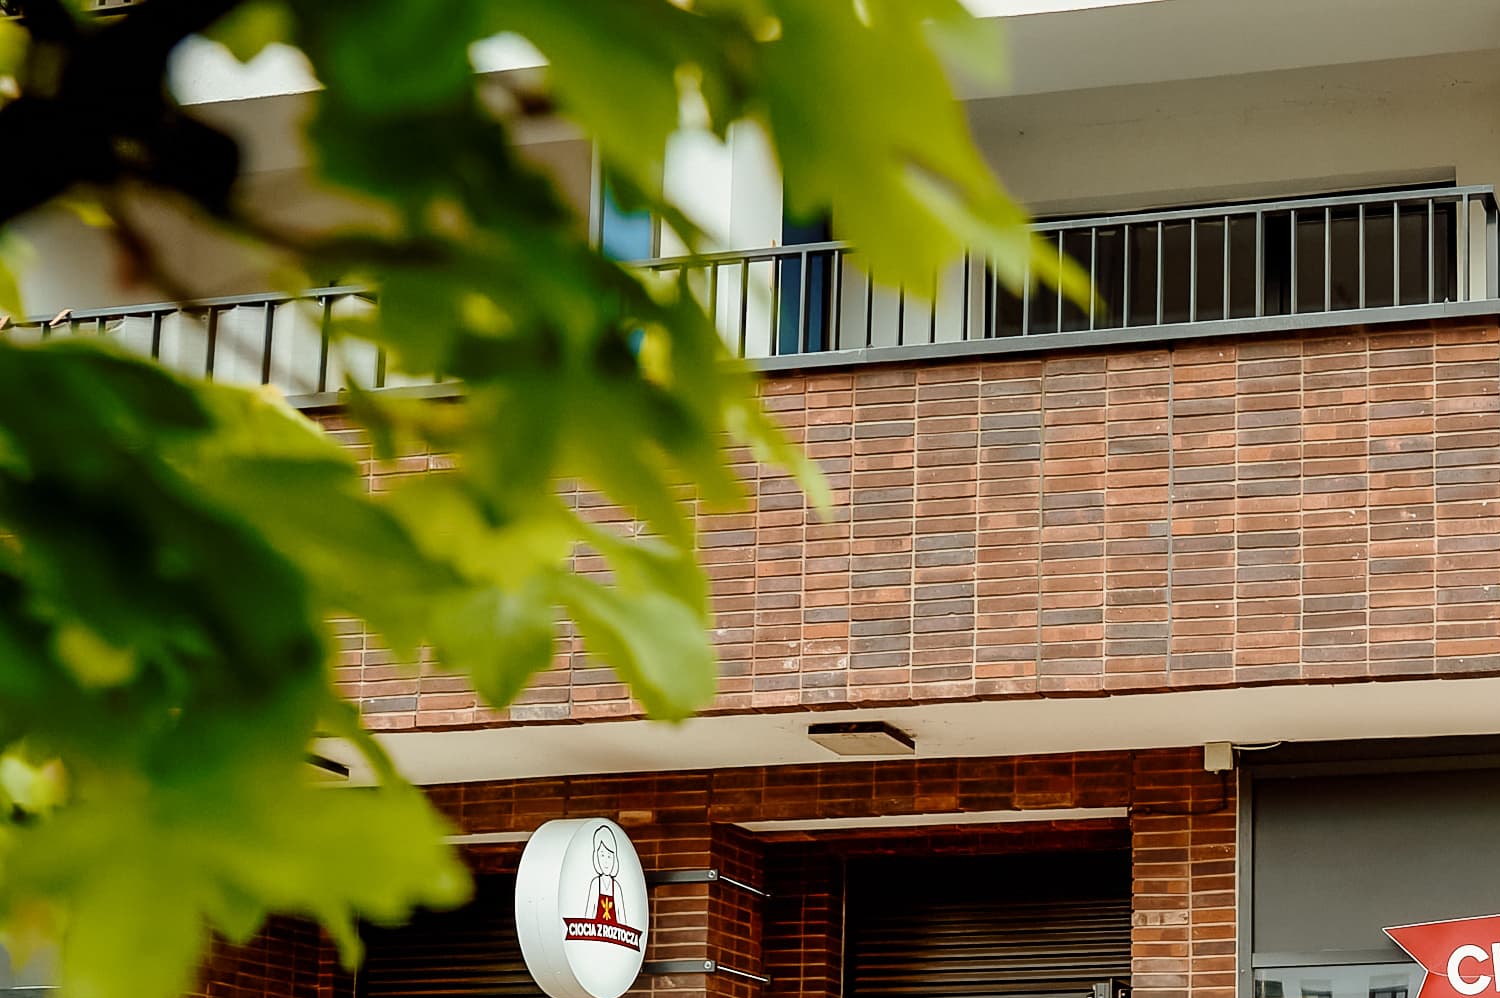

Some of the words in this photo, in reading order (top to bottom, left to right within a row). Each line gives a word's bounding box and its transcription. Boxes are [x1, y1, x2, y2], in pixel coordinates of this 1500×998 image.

[568, 922, 597, 937] CIOCIA
[596, 923, 603, 937] Z
[602, 924, 639, 947] ROZTOCZA
